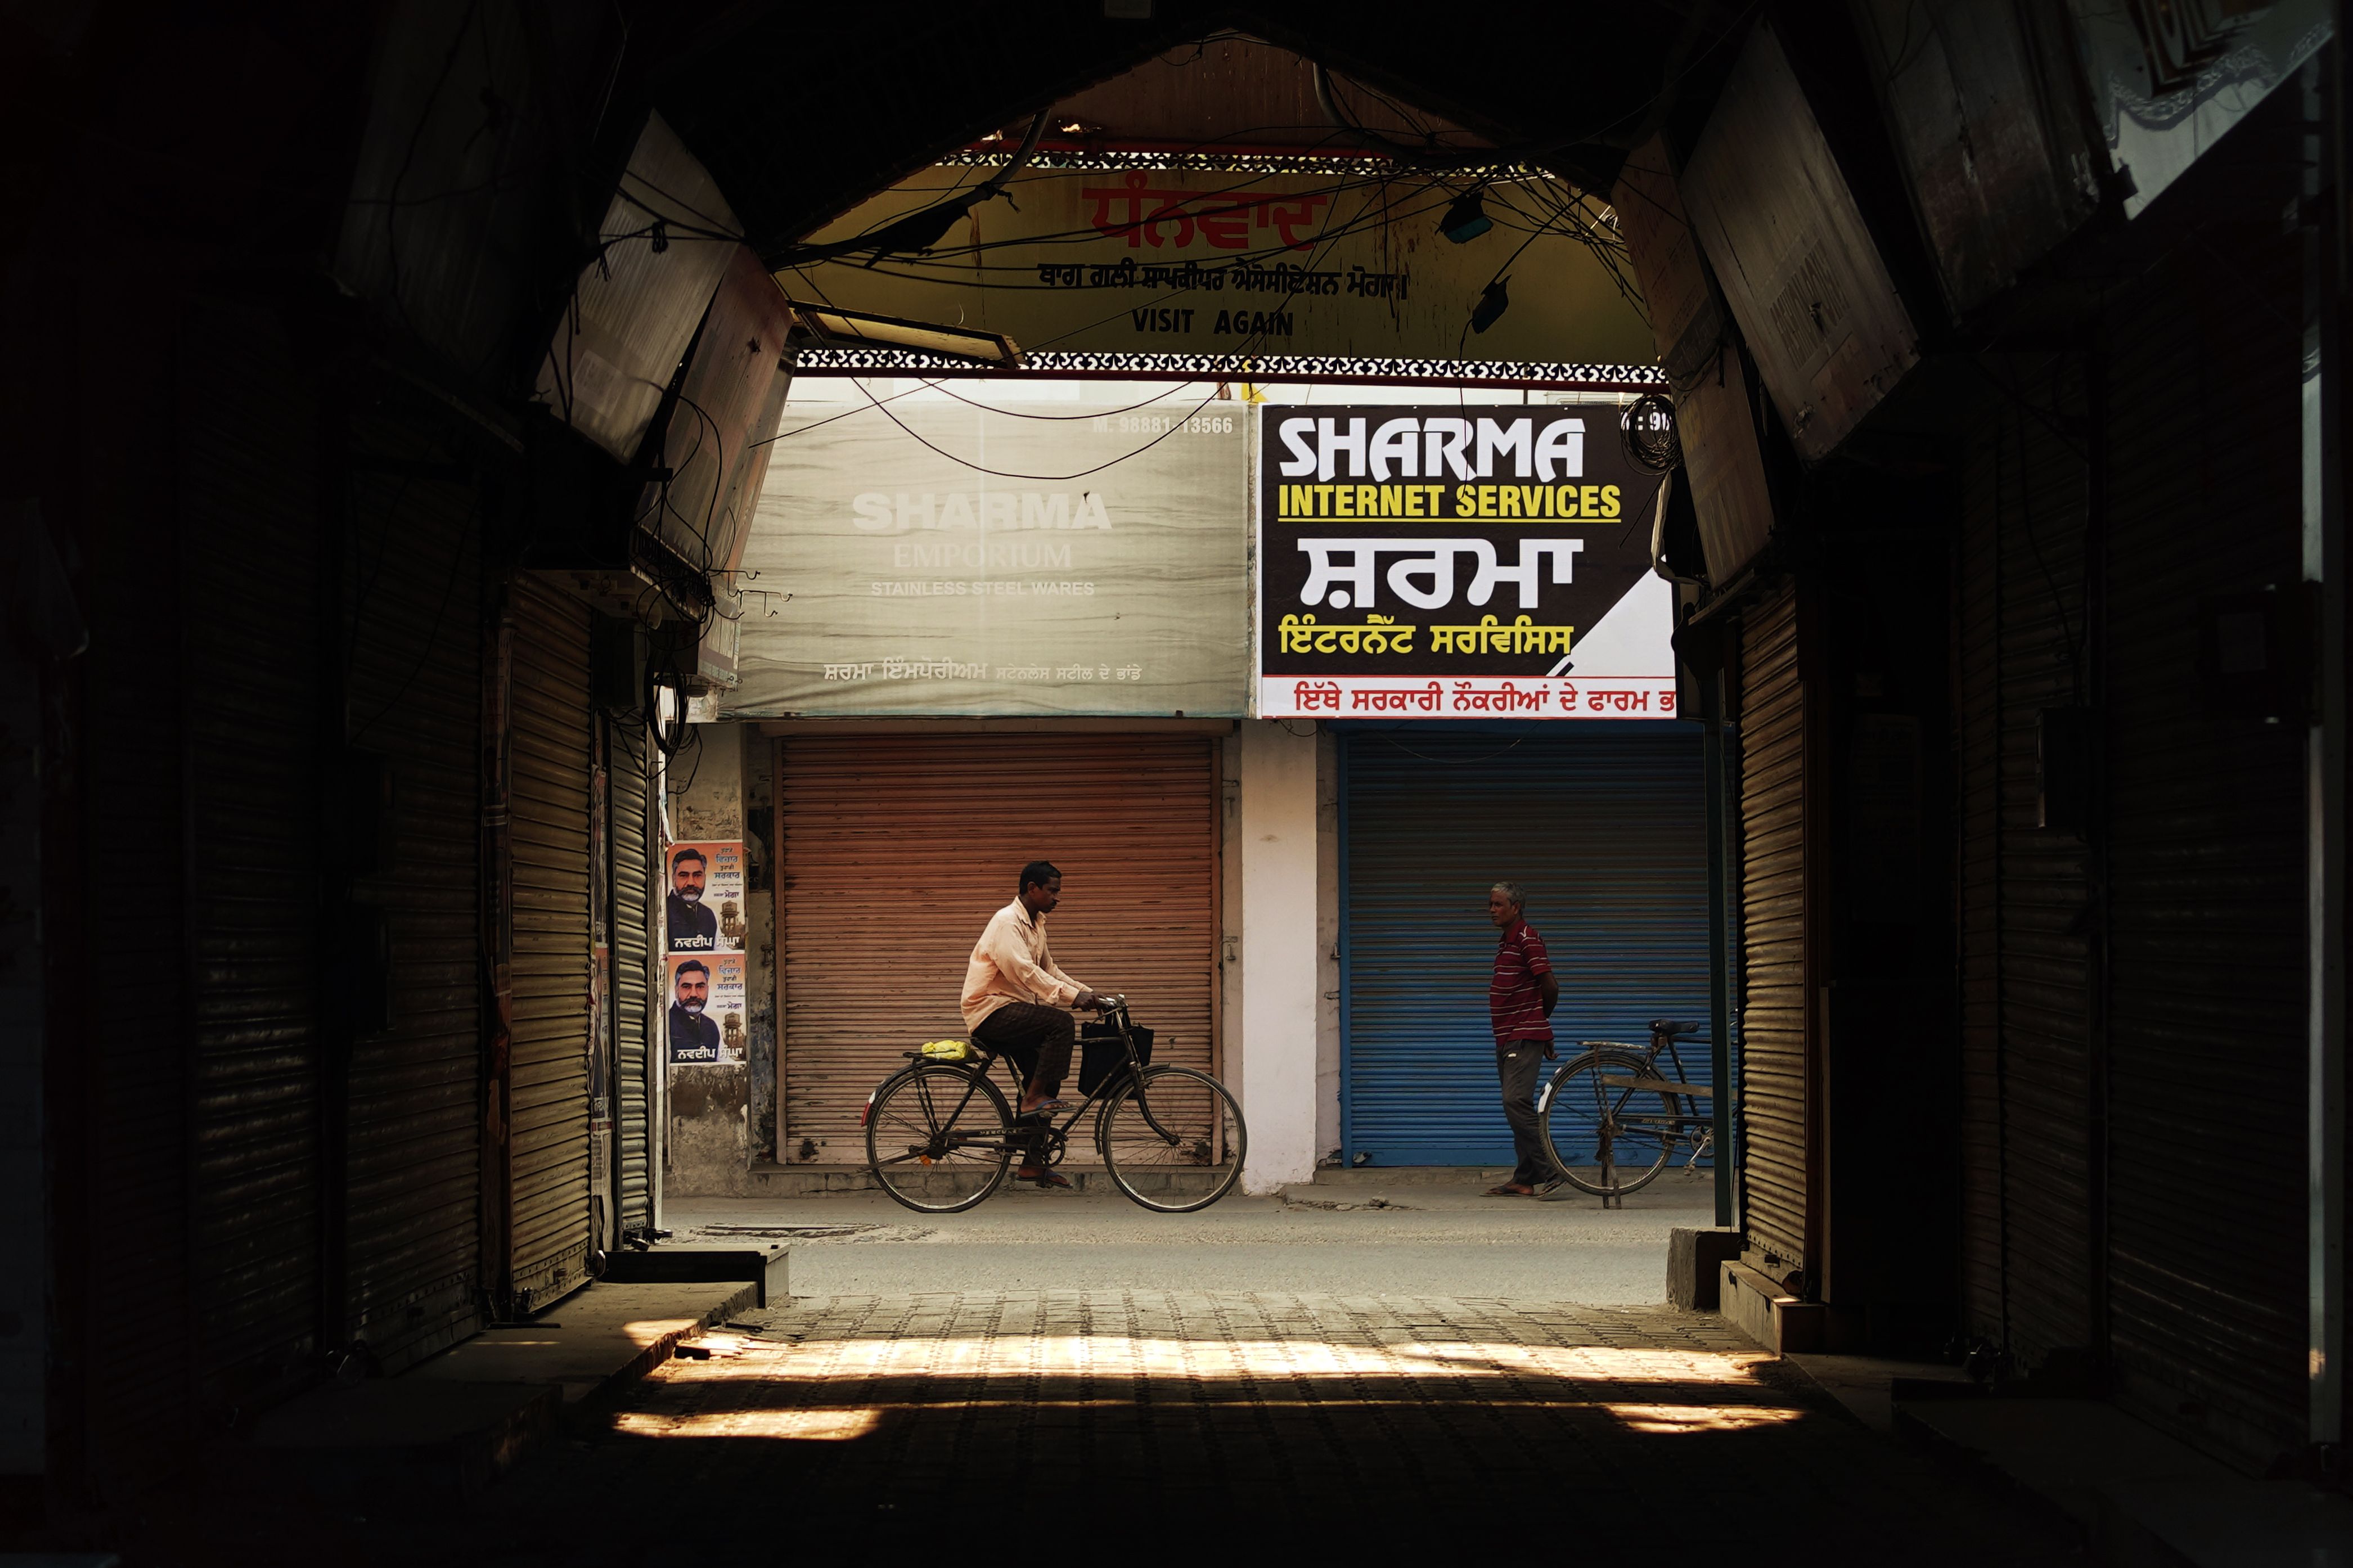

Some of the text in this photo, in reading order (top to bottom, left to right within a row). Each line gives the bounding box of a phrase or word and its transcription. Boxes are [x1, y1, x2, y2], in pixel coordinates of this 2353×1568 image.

[1082, 170, 1326, 251] ਧੰਨਵਾਦ
[1091, 257, 1137, 288] ਗਲੀ
[1132, 309, 1293, 336] VISIT AGAIN
[1093, 416, 1233, 434] M. 98881-13566
[1279, 418, 1585, 483] SHARMA
[852, 492, 1113, 530] SHARMA
[1279, 484, 1621, 517] INTERNET SERVICES
[894, 544, 1072, 567] EMPORIUM
[1297, 538, 1583, 609] ਸ਼ਰਮਾ
[871, 582, 1095, 596] STAINLESS STEEL WARES
[1278, 614, 1574, 654] ਇੰਟਰਨੈੱਟ ਸਰਵਿਸਿਸ
[824, 664, 874, 680] ਸ਼ਰਮਾ
[996, 663, 1050, 679] ਸਟੇਨਲੇਸ
[1056, 664, 1093, 680] ਸਟੀਲ
[1099, 664, 1110, 680] ਦੇ
[1117, 664, 1142, 681] ਭਾਂਡੇ
[1294, 681, 1342, 711] ਇੱਥੇ
[1351, 682, 1443, 711] ਸਰਕਾਰੀ
[1452, 682, 1550, 711] ਨੌਕਰੀਆਂ
[1559, 682, 1578, 711] ਦੇ
[1587, 691, 1650, 711] ਫਾਰਮ
[674, 934, 713, 948] ਨਵਦੀਪ
[677, 1045, 716, 1060] ਨਵਦੀਪ
